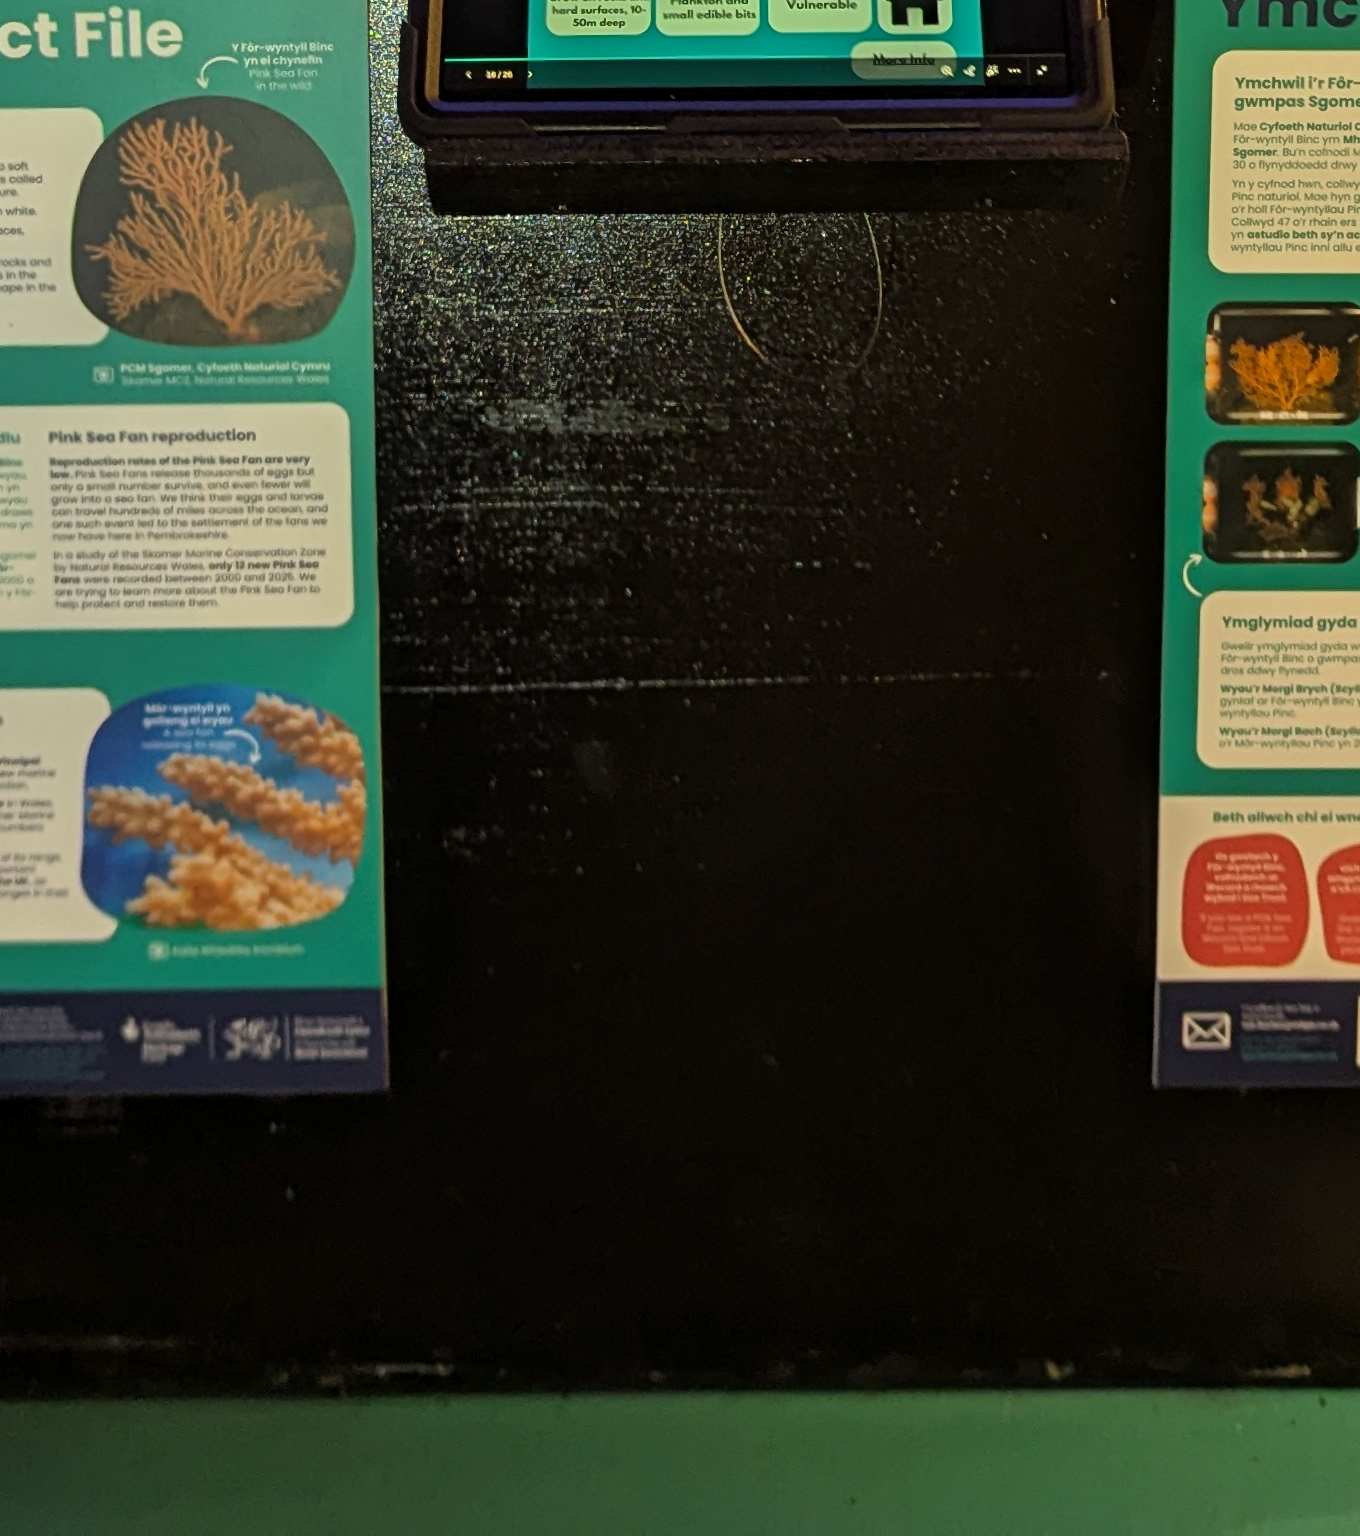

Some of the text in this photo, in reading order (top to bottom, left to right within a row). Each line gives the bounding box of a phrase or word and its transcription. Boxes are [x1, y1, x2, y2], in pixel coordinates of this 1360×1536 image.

[552, 4, 646, 15] hard surfaces, 10-
[663, 9, 756, 19] small edible bits
[572, 17, 625, 28] 50m deep
[74, 6, 183, 57] File
[48, 428, 256, 445] Pink Sea Fan reproduction
